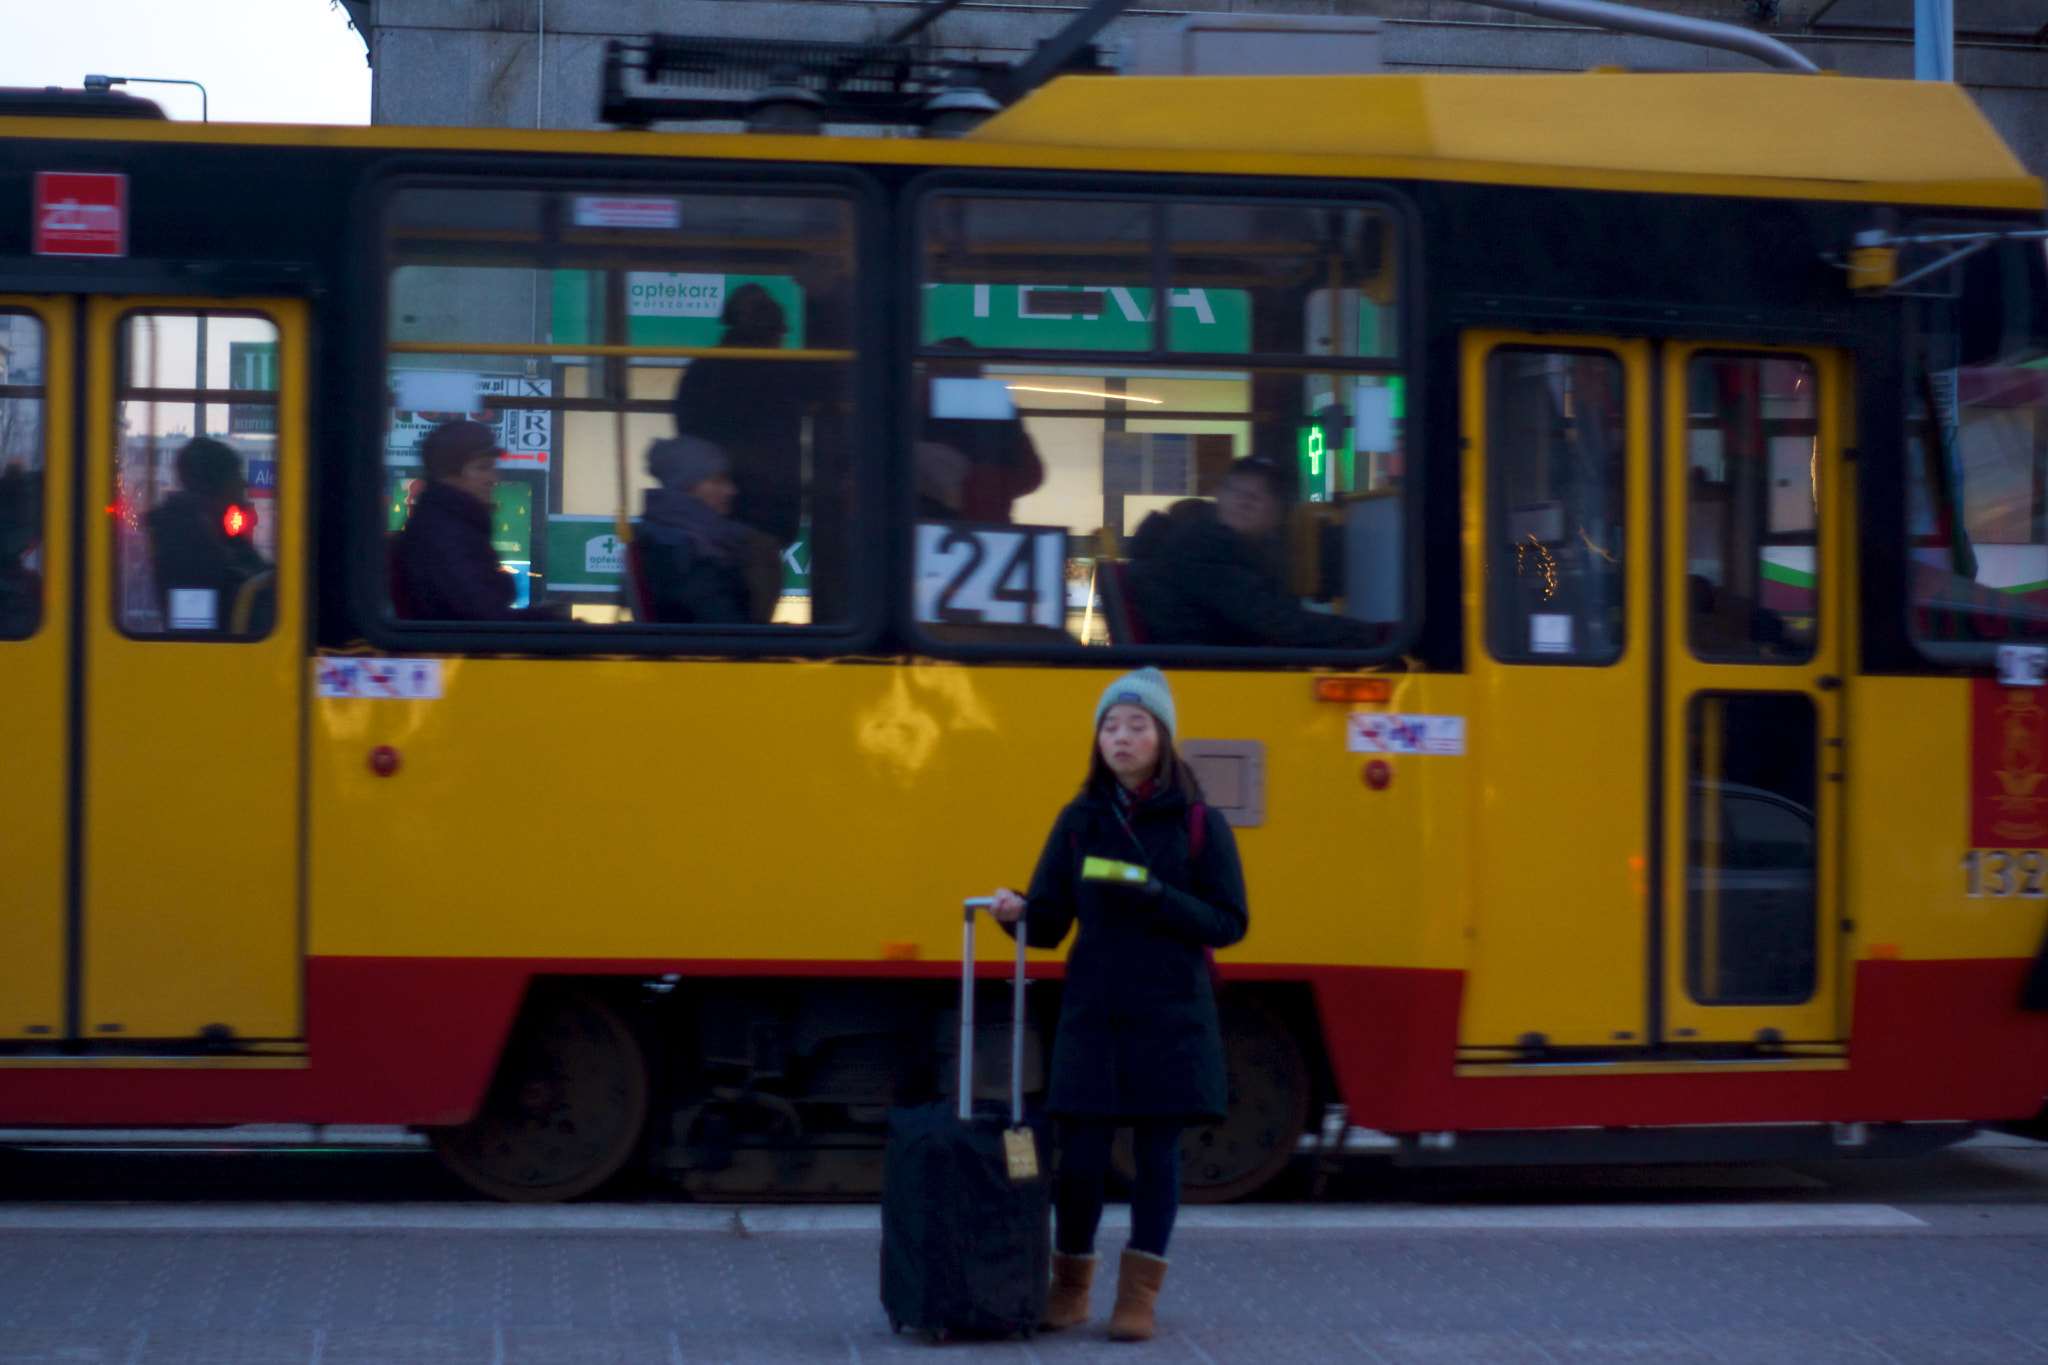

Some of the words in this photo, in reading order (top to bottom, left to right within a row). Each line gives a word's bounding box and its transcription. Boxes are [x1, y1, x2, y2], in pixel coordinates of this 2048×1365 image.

[631, 282, 718, 300] aptekarz
[922, 284, 1216, 323] TEKA
[522, 382, 548, 447] XRO
[255, 469, 277, 485] Ale
[935, 531, 1039, 622] 24
